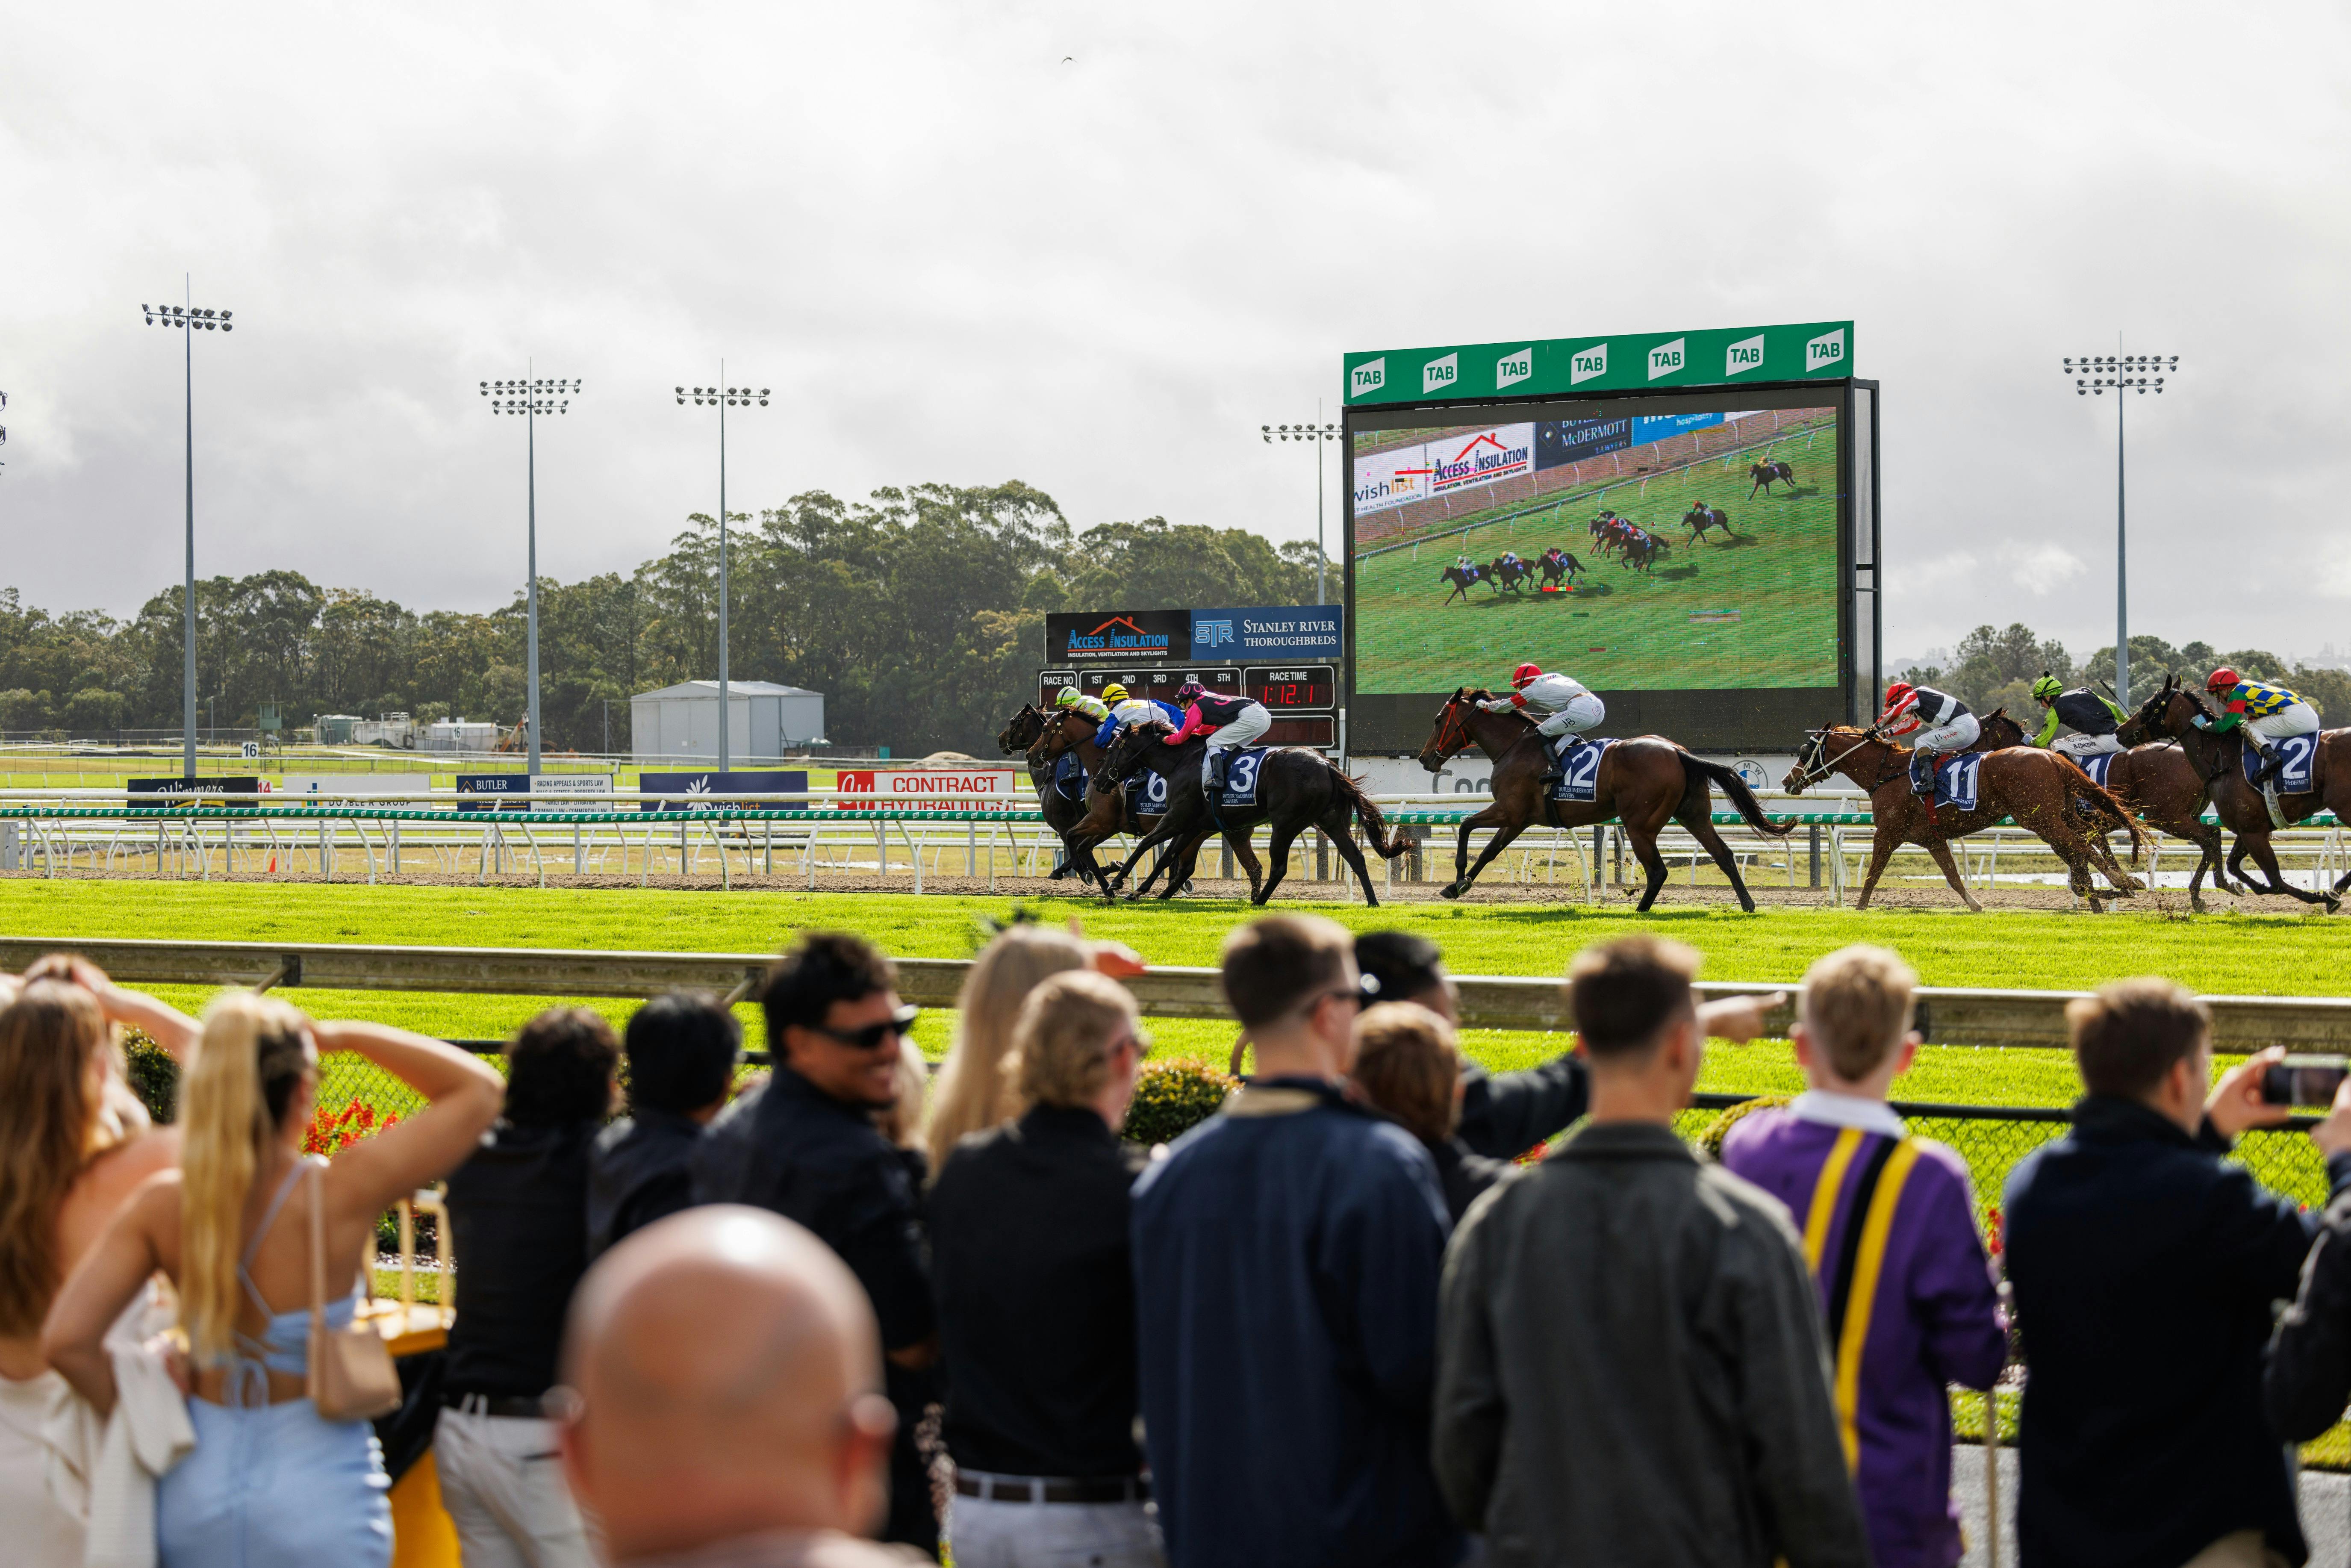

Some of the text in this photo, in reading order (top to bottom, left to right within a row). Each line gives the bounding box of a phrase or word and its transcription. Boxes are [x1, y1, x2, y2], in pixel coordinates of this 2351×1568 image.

[1730, 348, 1759, 363] TAB
[1810, 342, 1840, 358] TAB
[1575, 357, 1603, 372] TAB
[1652, 352, 1681, 367] TAB
[1427, 366, 1454, 380] TAB
[1500, 361, 1528, 376] TAB
[1355, 371, 1382, 385] TAB
[1562, 419, 1627, 447] McDERMOTT
[1433, 447, 1528, 483] ACCESS INSULATION
[1195, 620, 1235, 648] STR
[1244, 619, 1336, 634] STANLEY RIVER
[1067, 628, 1168, 649] ACCESS INSULATION
[1244, 636, 1336, 647] THOROUGHBREDS
[1043, 676, 1074, 685] RACE NO
[1091, 673, 1230, 684] 1ST 2ND 3RD 4TH 5TH
[1270, 672, 1307, 681] RACE TIME
[1562, 718, 1576, 728] JB
[454, 727, 461, 738] 16
[243, 744, 257, 757] 16
[2282, 737, 2310, 779] 2
[1230, 755, 1256, 793] 3
[1564, 746, 1599, 787] 12
[258, 781, 271, 793] 14
[476, 780, 507, 790] BUTLER
[893, 777, 998, 793] CONTRACT
[1147, 772, 1167, 802] 6
[1946, 760, 1978, 799] 11
